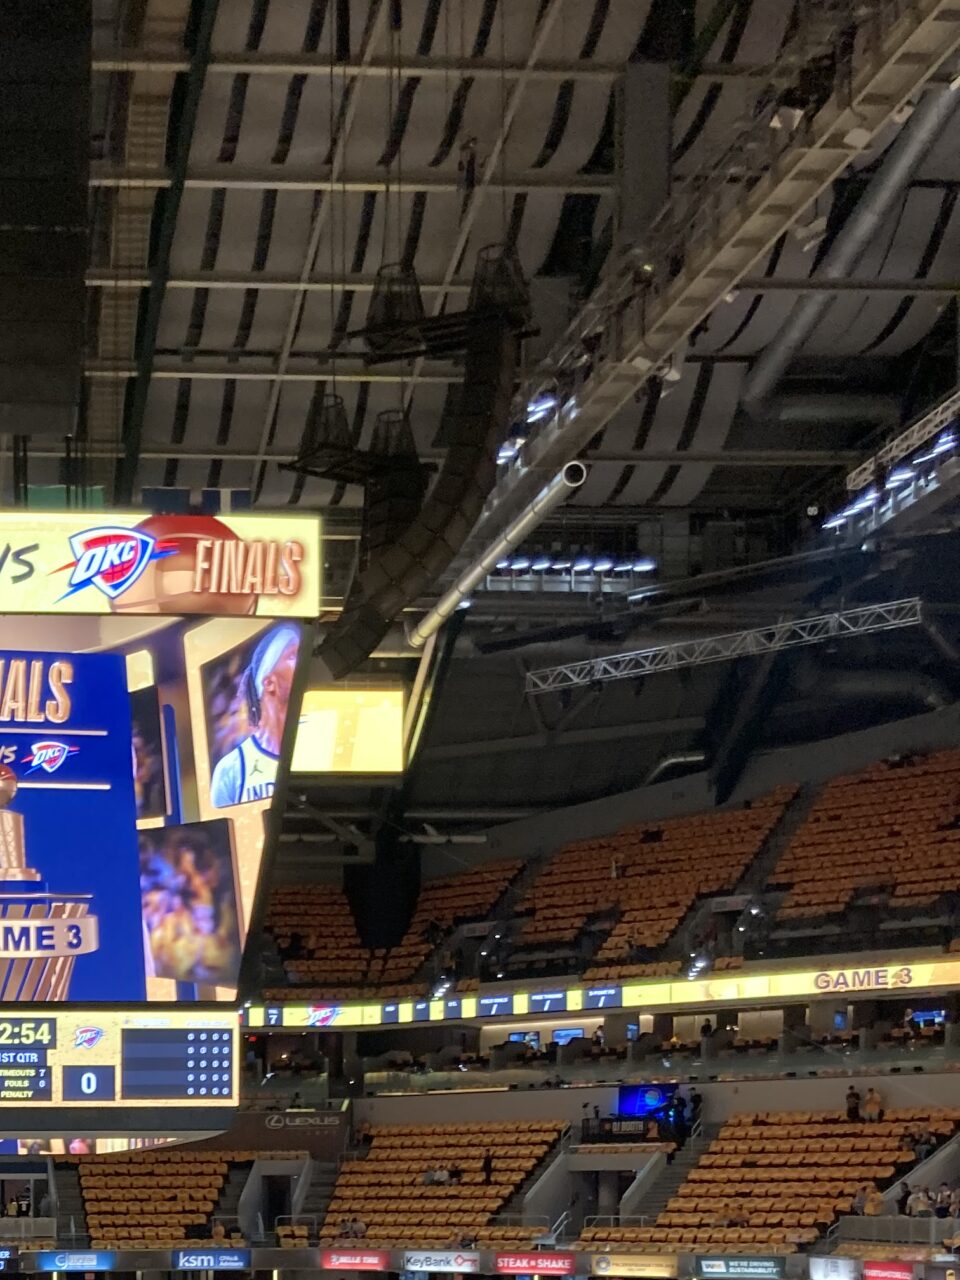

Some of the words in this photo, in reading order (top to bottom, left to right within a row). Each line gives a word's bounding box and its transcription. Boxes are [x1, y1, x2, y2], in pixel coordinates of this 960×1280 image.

[193, 538, 304, 596] FINALS
[32, 745, 66, 766] OKC
[65, 925, 82, 951] 3
[814, 968, 890, 990] GAME
[899, 967, 913, 985] 3
[269, 1015, 277, 1025] 7
[16, 1053, 38, 1063] QTR
[39, 1069, 46, 1077] 7
[4, 1080, 30, 1088] FOULS
[81, 1072, 97, 1094] 0
[0, 1090, 34, 1098] PENALTY
[285, 1116, 340, 1125] LEXUS
[178, 1251, 214, 1267] ksm
[405, 1256, 452, 1268] KeyBank
[497, 1257, 529, 1268] STEAK
[536, 1257, 571, 1268] SHAKE
